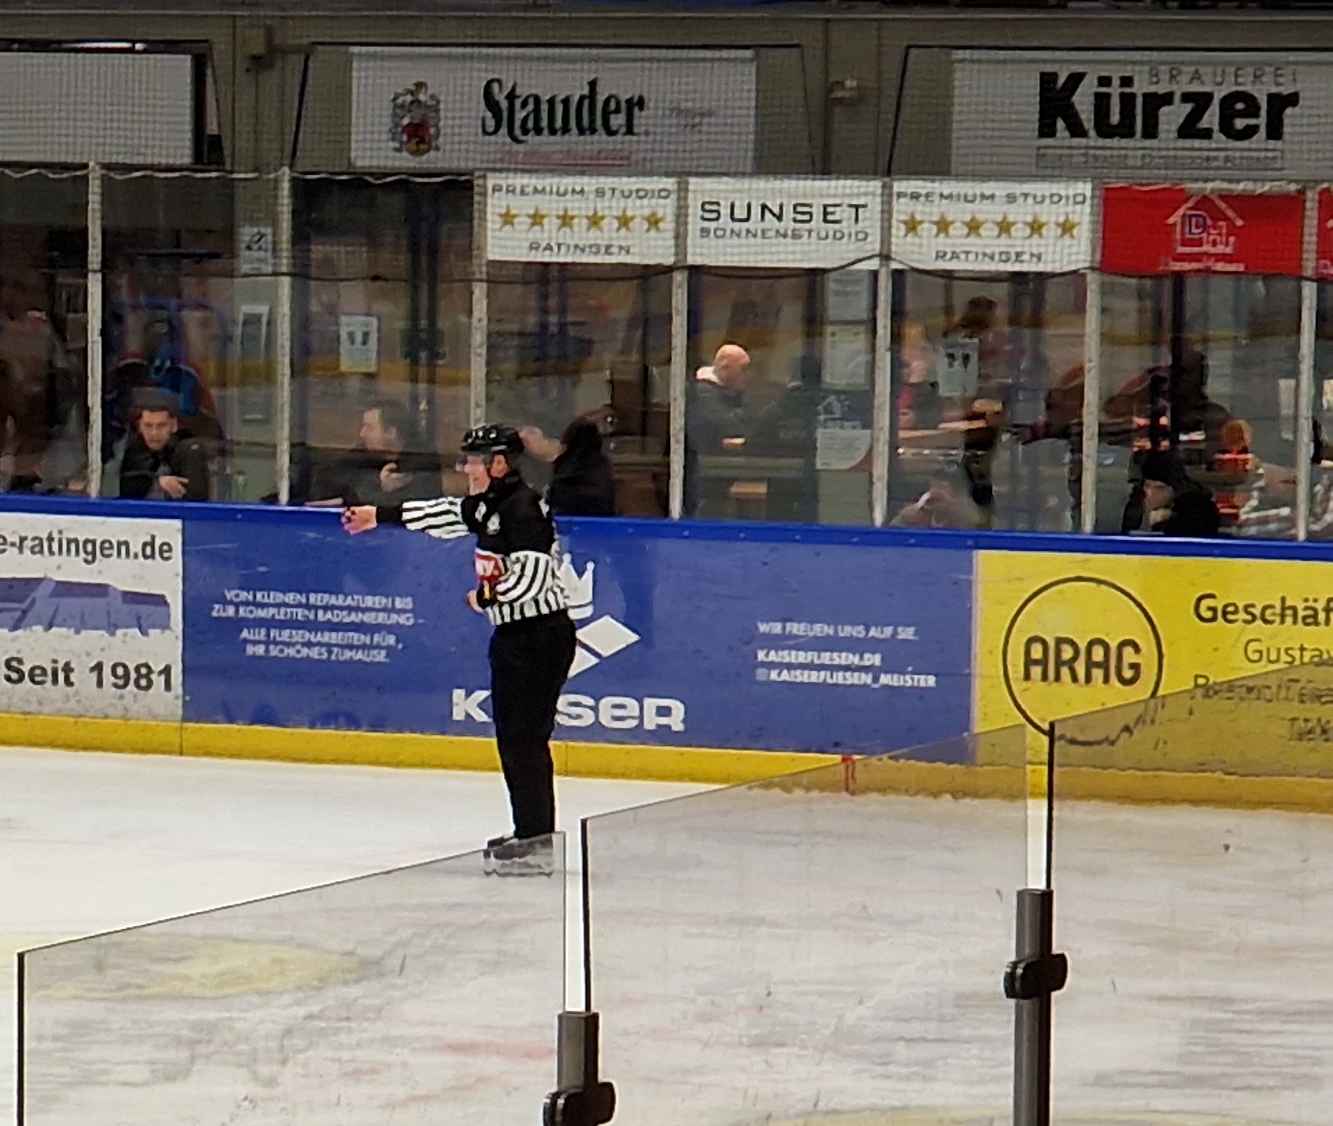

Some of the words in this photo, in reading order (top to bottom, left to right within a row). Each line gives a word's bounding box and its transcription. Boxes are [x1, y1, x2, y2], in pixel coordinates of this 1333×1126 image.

[1147, 66, 1298, 86] BRAUEREI
[481, 77, 646, 144] Stauder
[1036, 71, 1301, 142] Kürzer
[491, 184, 586, 199] PREMIUM
[595, 186, 673, 201] STUDIO
[896, 190, 996, 204] PREMIUM
[1004, 191, 1088, 206] STUDIO
[699, 200, 870, 226] SUNSET
[699, 225, 870, 243] SONNENSTUDIO
[529, 241, 631, 257] RATINGEN
[934, 249, 1044, 264] RATINGEN
[224, 589, 254, 601] VON
[256, 591, 307, 605] KLEINEN
[308, 592, 393, 609] REPARATUREN
[394, 596, 414, 610] BIS
[211, 604, 236, 618] ZUR
[238, 605, 316, 621] KOMPLETTEN
[317, 608, 415, 626] BADSANIERUNG
[240, 627, 267, 641] ALLE
[269, 629, 371, 646] FLIESENARBEITEN
[757, 621, 783, 636] WIR
[785, 622, 835, 638] FREUEN
[837, 624, 866, 638] UNS
[867, 625, 893, 639] AUF
[246, 644, 266, 656] IHR
[268, 645, 328, 660] SCHÖNES
[756, 649, 882, 667] KAISERFLIESEN.DE
[1022, 635, 1142, 687] ARAG
[3, 656, 74, 688] Seit
[89, 660, 173, 693] 1981
